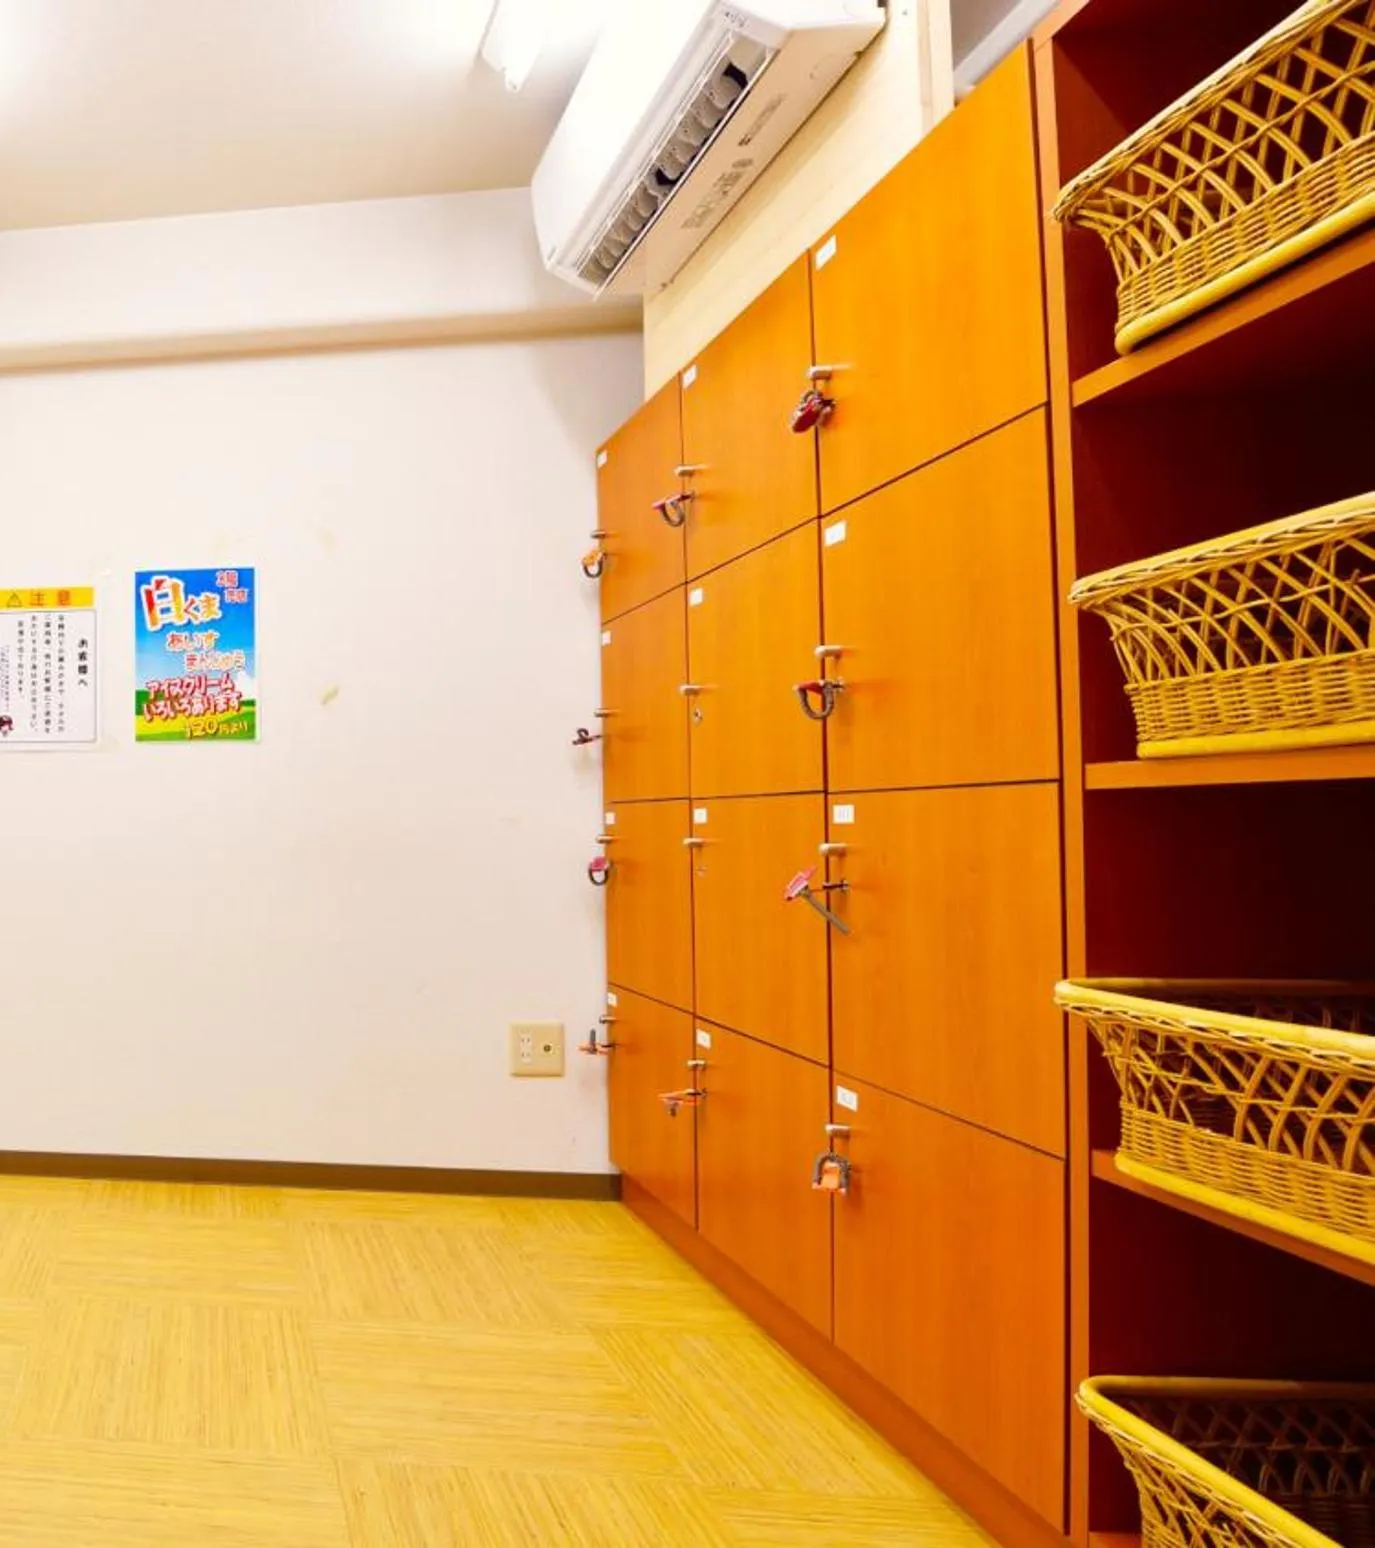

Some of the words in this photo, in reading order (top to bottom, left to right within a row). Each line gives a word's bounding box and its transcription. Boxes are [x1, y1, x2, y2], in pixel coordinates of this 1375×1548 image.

[78, 638, 88, 686] お客様へ
[145, 672, 236, 700] アイスクリーム
[143, 691, 243, 721] いろいろあります
